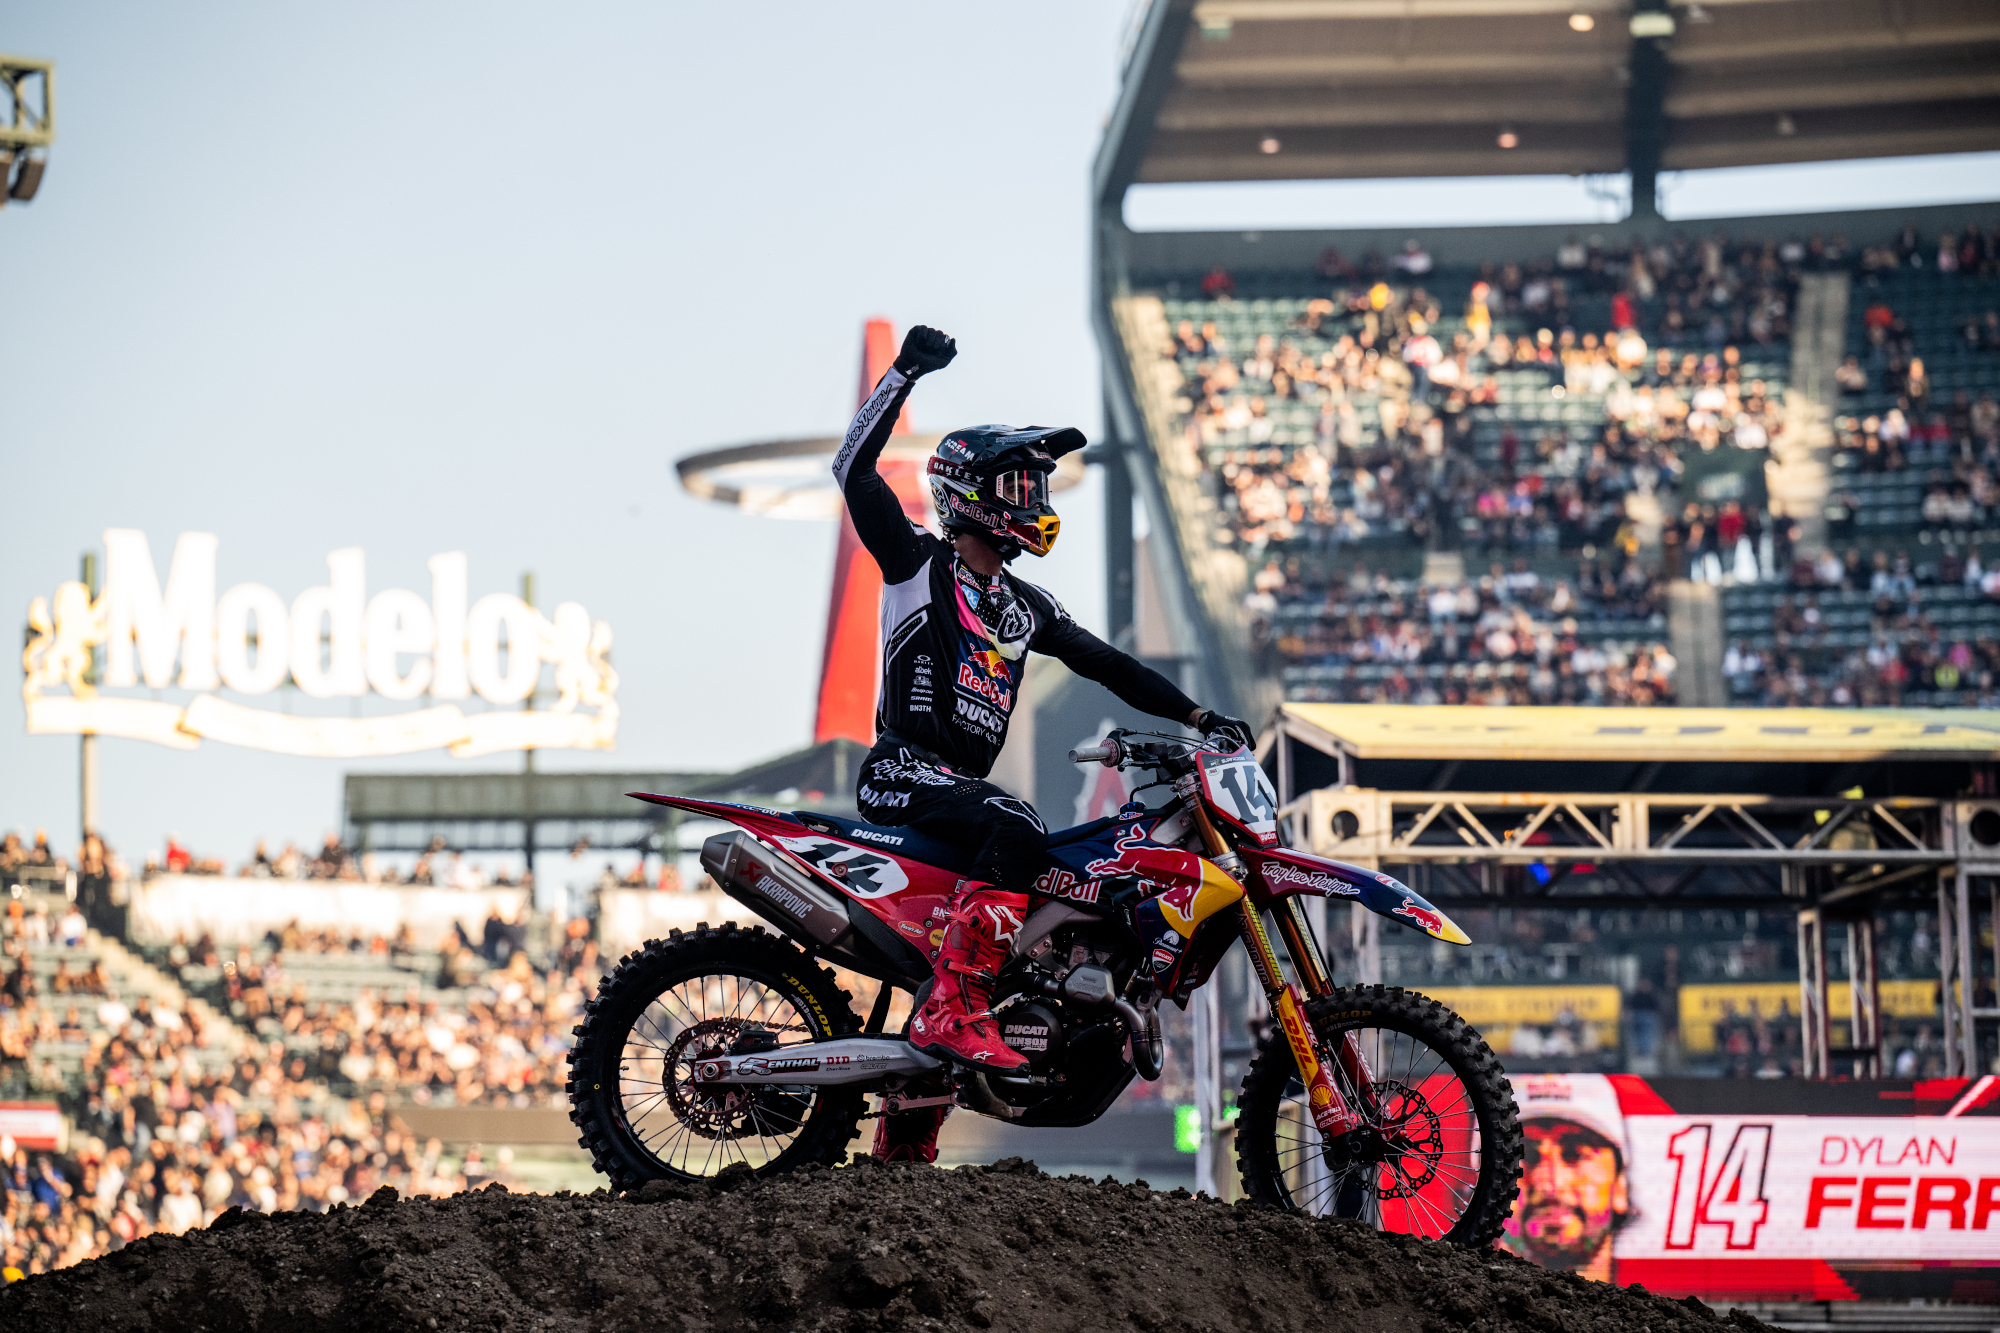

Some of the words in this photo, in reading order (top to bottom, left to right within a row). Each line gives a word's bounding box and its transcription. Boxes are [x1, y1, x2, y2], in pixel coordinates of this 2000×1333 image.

[832, 442, 852, 471] Troy
[846, 425, 864, 448] Lee
[857, 383, 893, 427] Designs
[944, 438, 976, 461] SCREAM
[933, 461, 985, 483] OAKLEY
[950, 493, 973, 519] Red
[972, 506, 999, 529] Bull
[103, 527, 540, 704] Modelo
[957, 661, 991, 698] Red
[909, 704, 932, 713] BN3TH
[951, 713, 986, 736] FACTORY
[1219, 764, 1277, 825] 14
[850, 828, 905, 846] DUCATI
[787, 841, 892, 897] 14
[1261, 861, 1288, 884] Troy
[1285, 865, 1309, 885] Lee
[1308, 871, 1361, 897] Designs
[755, 874, 814, 919] AKRAPOVIČ
[1052, 870, 1102, 904] Bull
[931, 933, 943, 941] Mip
[1154, 950, 1173, 961] DUCATI
[787, 976, 833, 1037] DUNLOP
[1004, 1024, 1049, 1036] DUCATI
[1283, 1015, 1313, 1070] DHL
[738, 1057, 819, 1076] RENTHAL
[825, 1055, 850, 1066] DID
[1303, 1019, 1340, 1094] DULOP
[1819, 1136, 1957, 1166] DYLAN
[1664, 1123, 1773, 1250] 14
